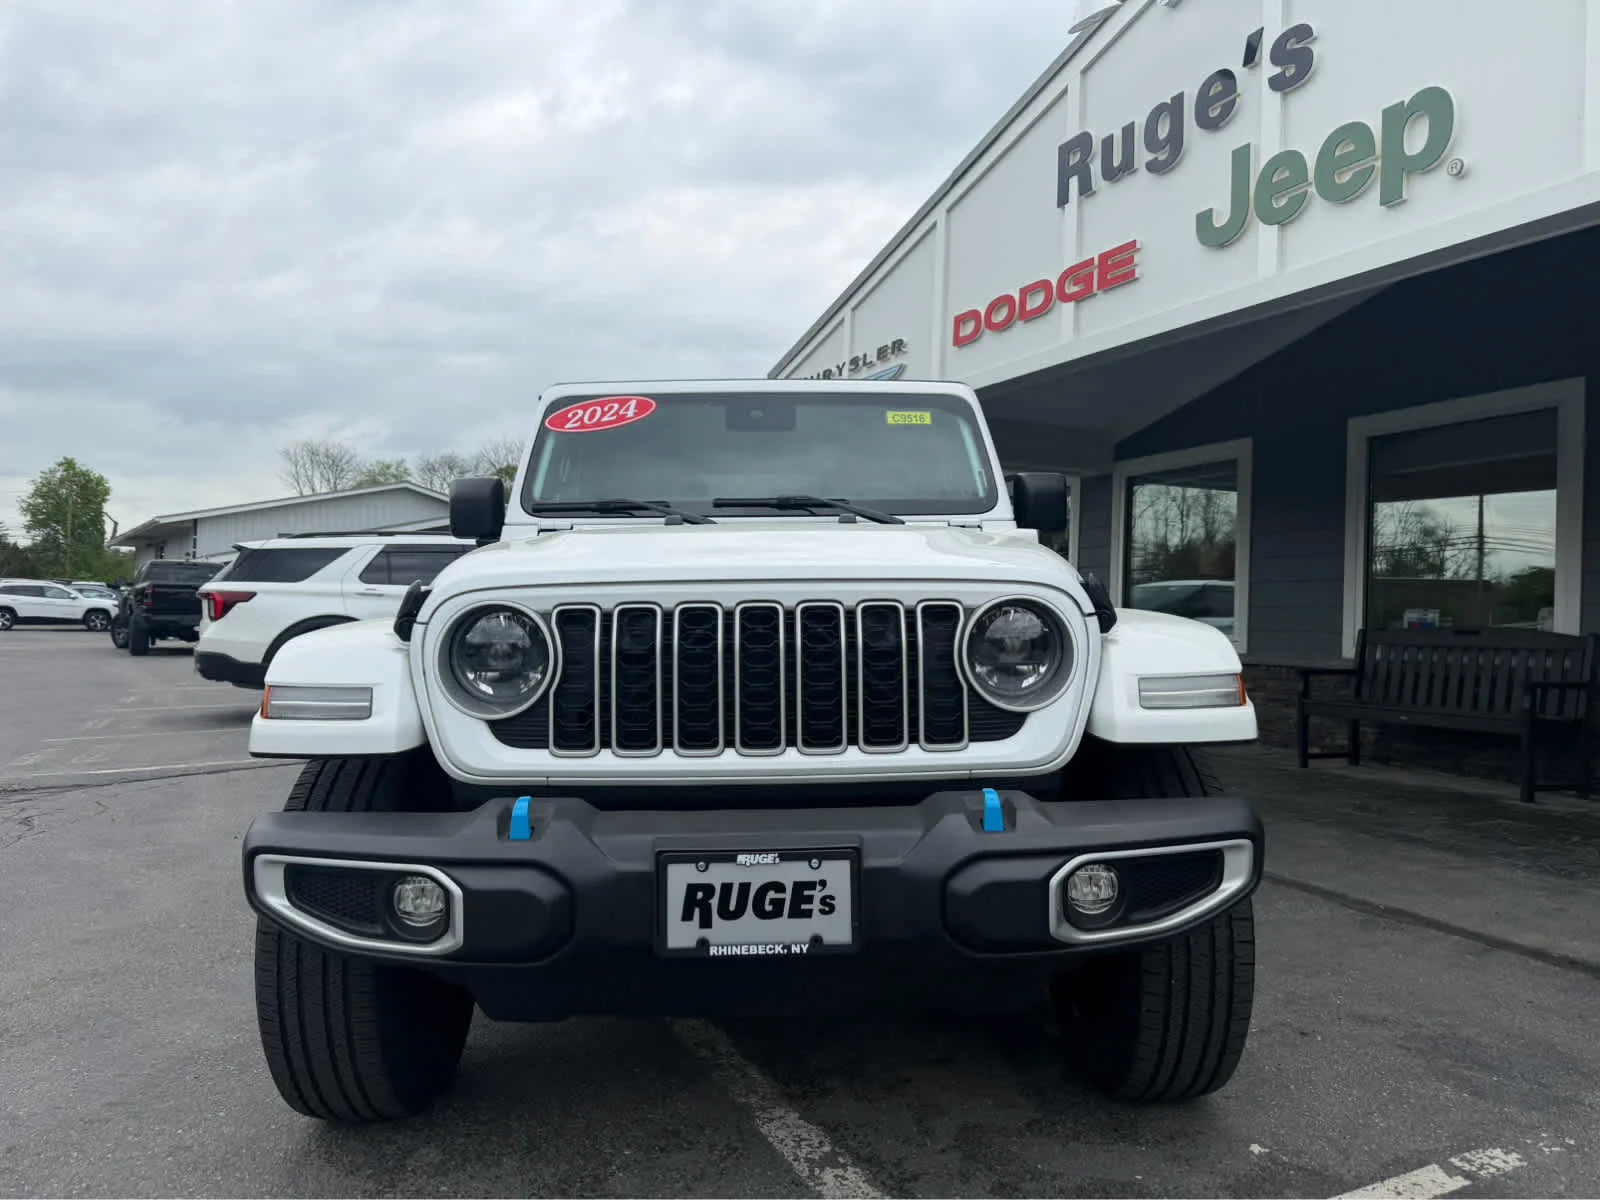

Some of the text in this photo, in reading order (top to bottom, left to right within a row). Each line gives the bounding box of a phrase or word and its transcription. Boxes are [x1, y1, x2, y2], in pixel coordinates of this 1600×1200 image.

[1057, 23, 1317, 208] Ruge's
[1196, 86, 1455, 248] Jeep
[953, 239, 1141, 348] DODGE
[803, 338, 907, 380] RYSLER
[564, 399, 638, 429] 2024
[680, 879, 836, 929] RUGE's
[709, 943, 809, 956] RHINEBECK, NY
